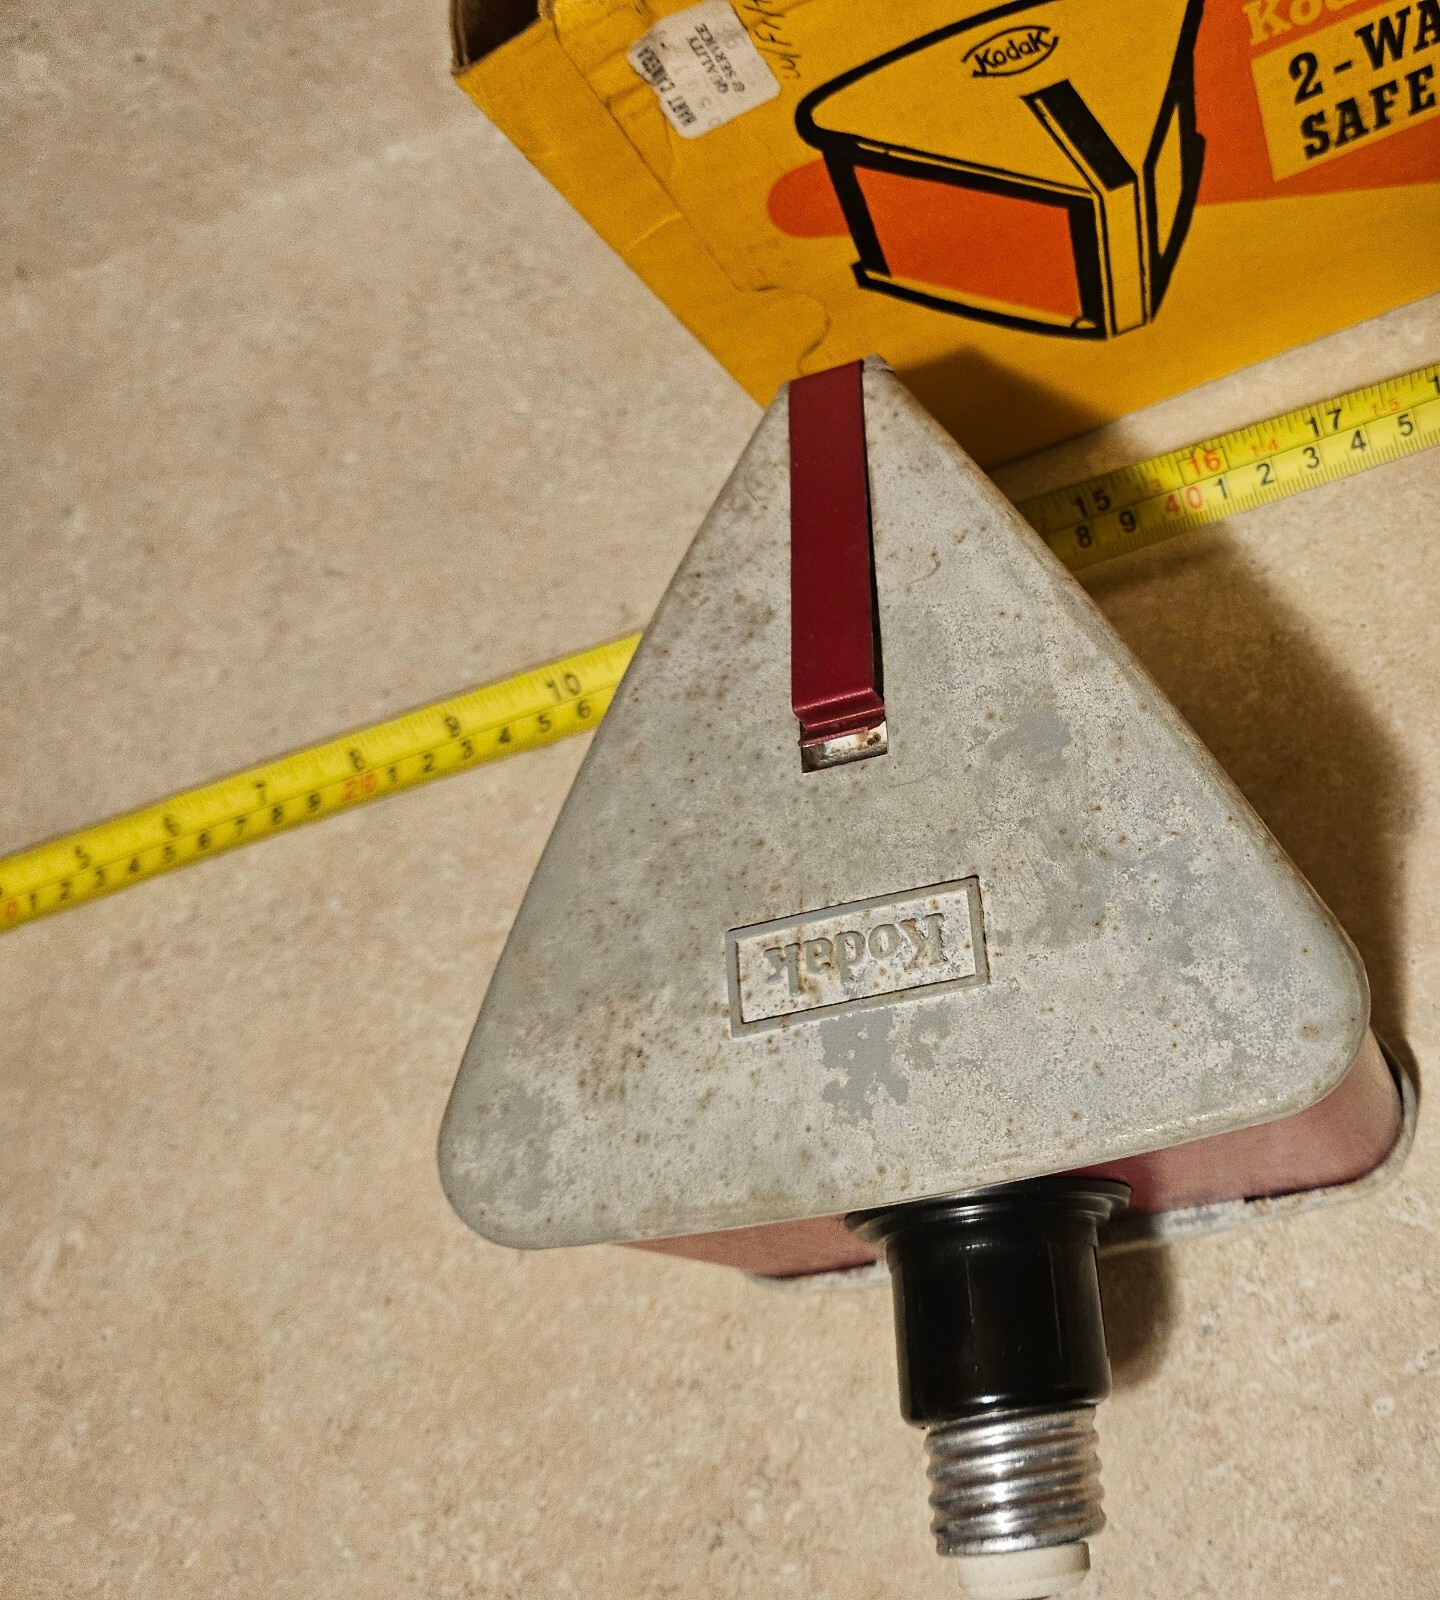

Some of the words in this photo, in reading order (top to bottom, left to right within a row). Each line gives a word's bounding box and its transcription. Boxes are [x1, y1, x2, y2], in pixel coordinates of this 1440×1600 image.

[636, 47, 676, 93] CAMERA
[687, 36, 730, 95] QUALITY
[694, 22, 738, 80] SERVICE
[972, 27, 1053, 77] Kodak
[666, 95, 698, 128] HART
[1073, 488, 1111, 518] 15
[1188, 448, 1222, 477] 16
[1307, 407, 1344, 438] 17
[1073, 524, 1093, 549] 8
[1118, 509, 1137, 534] 9
[1163, 485, 1205, 517] 40
[1213, 477, 1228, 500] 1
[1256, 463, 1275, 487] 2
[1301, 446, 1321, 470] 3
[1350, 429, 1368, 452] 4
[1397, 412, 1414, 436] 5
[544, 671, 582, 703] 10
[497, 725, 513, 745] 4
[536, 712, 553, 733] 5
[574, 698, 592, 719] 6
[762, 912, 948, 997] Kodak
